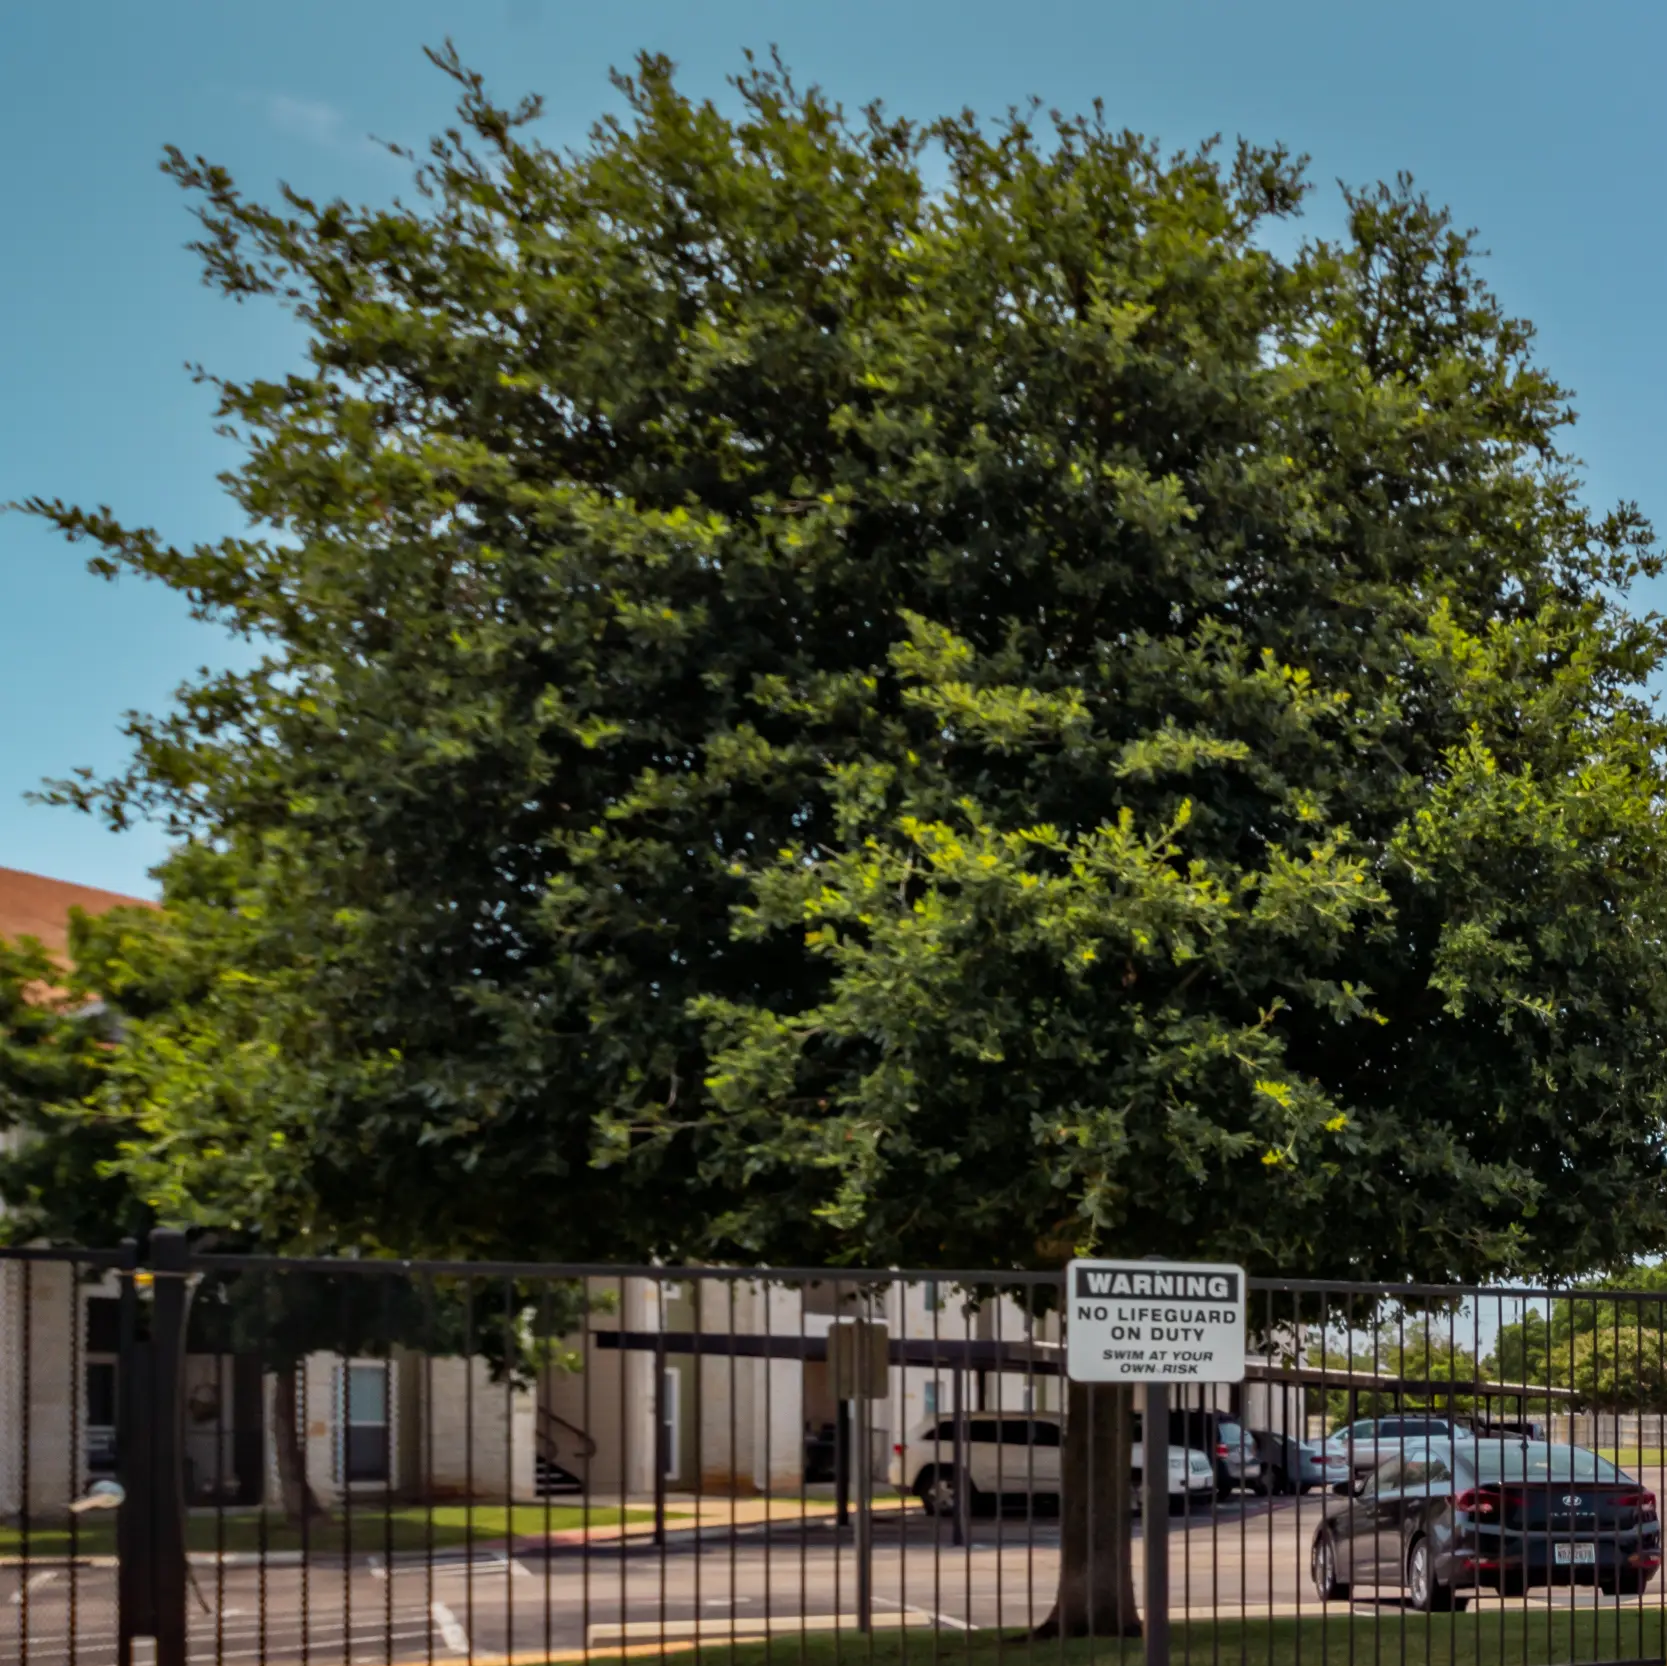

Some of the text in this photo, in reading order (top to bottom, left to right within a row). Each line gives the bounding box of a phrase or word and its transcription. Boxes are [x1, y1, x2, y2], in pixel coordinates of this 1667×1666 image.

[1087, 1272, 1228, 1298] WARNING
[1078, 1307, 1236, 1324] NO LIFEGUARD
[1111, 1327, 1205, 1342] ON DUTY
[1103, 1350, 1213, 1361] SWIM AT YOUR
[1120, 1364, 1198, 1374] OWN RISK
